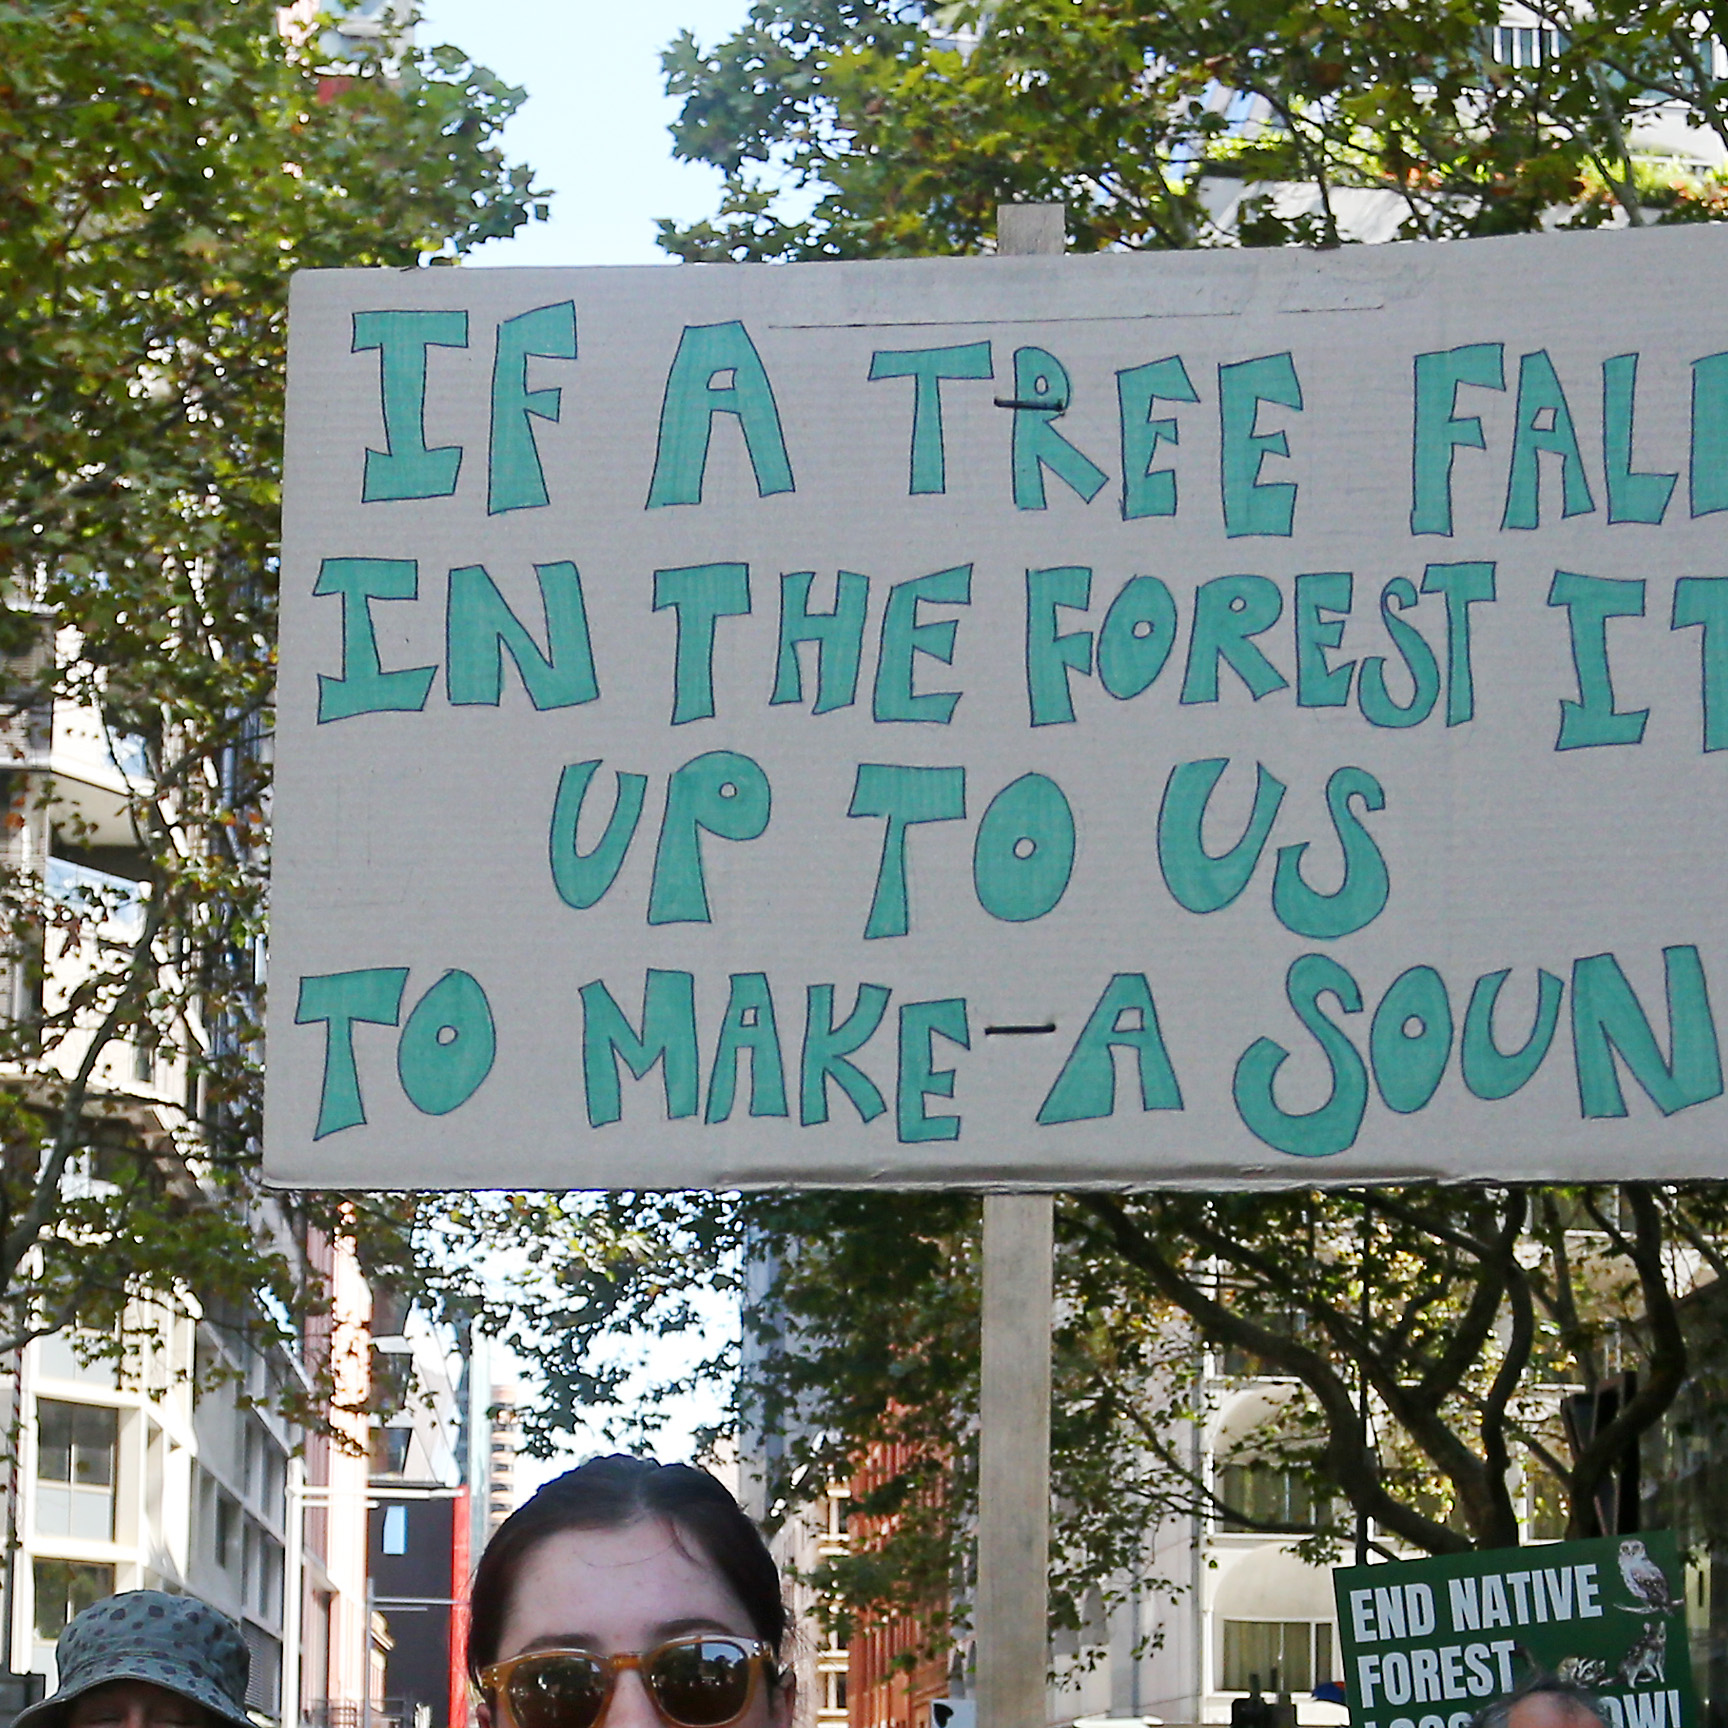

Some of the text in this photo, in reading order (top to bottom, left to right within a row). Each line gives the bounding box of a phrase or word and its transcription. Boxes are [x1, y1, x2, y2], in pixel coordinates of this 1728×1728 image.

[351, 299, 577, 515] IF
[646, 320, 794, 509] A
[869, 341, 1303, 536] TREE
[314, 557, 599, 724] IN
[652, 560, 974, 724] THE
[1026, 560, 1498, 728] FOREST
[549, 749, 1389, 939] UP TO US
[296, 966, 497, 1139] TO
[581, 968, 972, 1143] MAKE
[1037, 971, 1183, 1125] A
[1349, 1564, 1604, 1643] END NATIVE
[1357, 1640, 1515, 1708] FOREST
